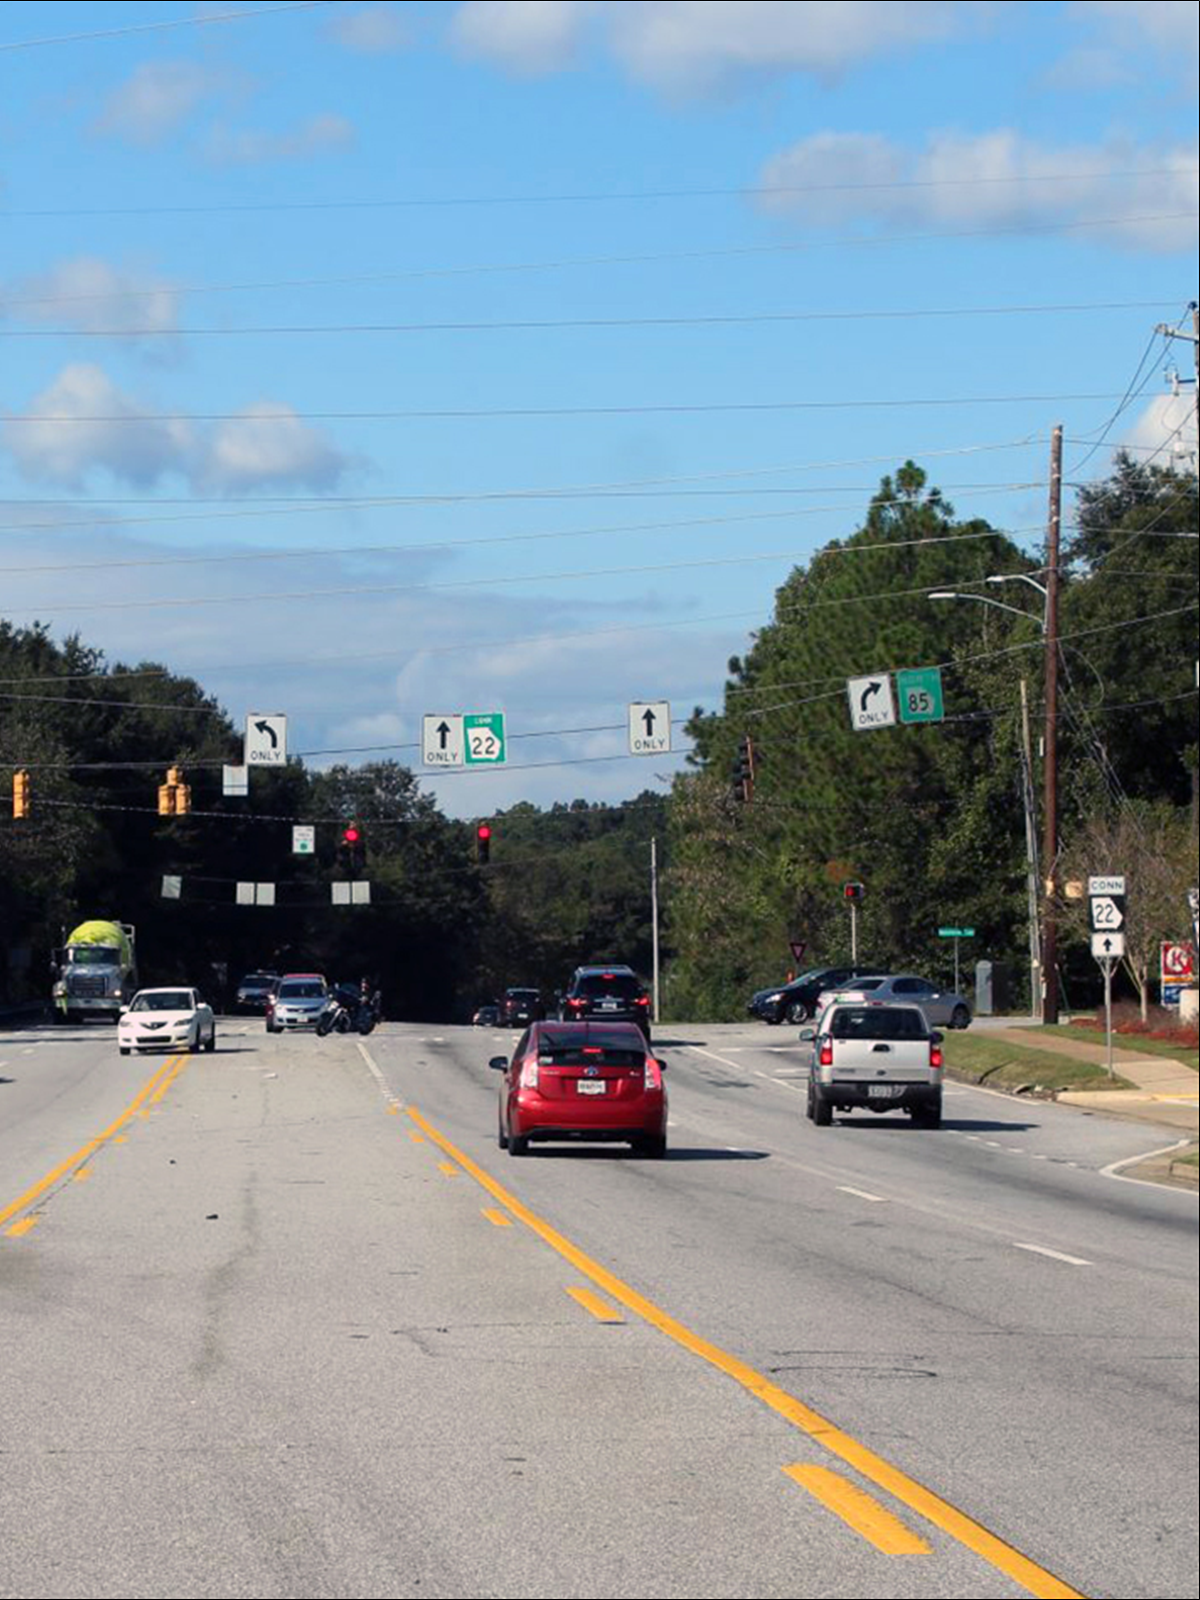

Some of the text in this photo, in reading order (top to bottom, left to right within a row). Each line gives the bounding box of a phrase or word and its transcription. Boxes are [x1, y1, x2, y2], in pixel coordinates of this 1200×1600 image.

[908, 692, 930, 712] 85
[859, 711, 889, 724] ONLY
[472, 736, 496, 755] 22
[634, 739, 665, 750] ONLY
[250, 750, 281, 761] ONLY
[427, 752, 458, 762] ONLY
[1091, 880, 1123, 891] CONN
[1095, 904, 1114, 923] 22
